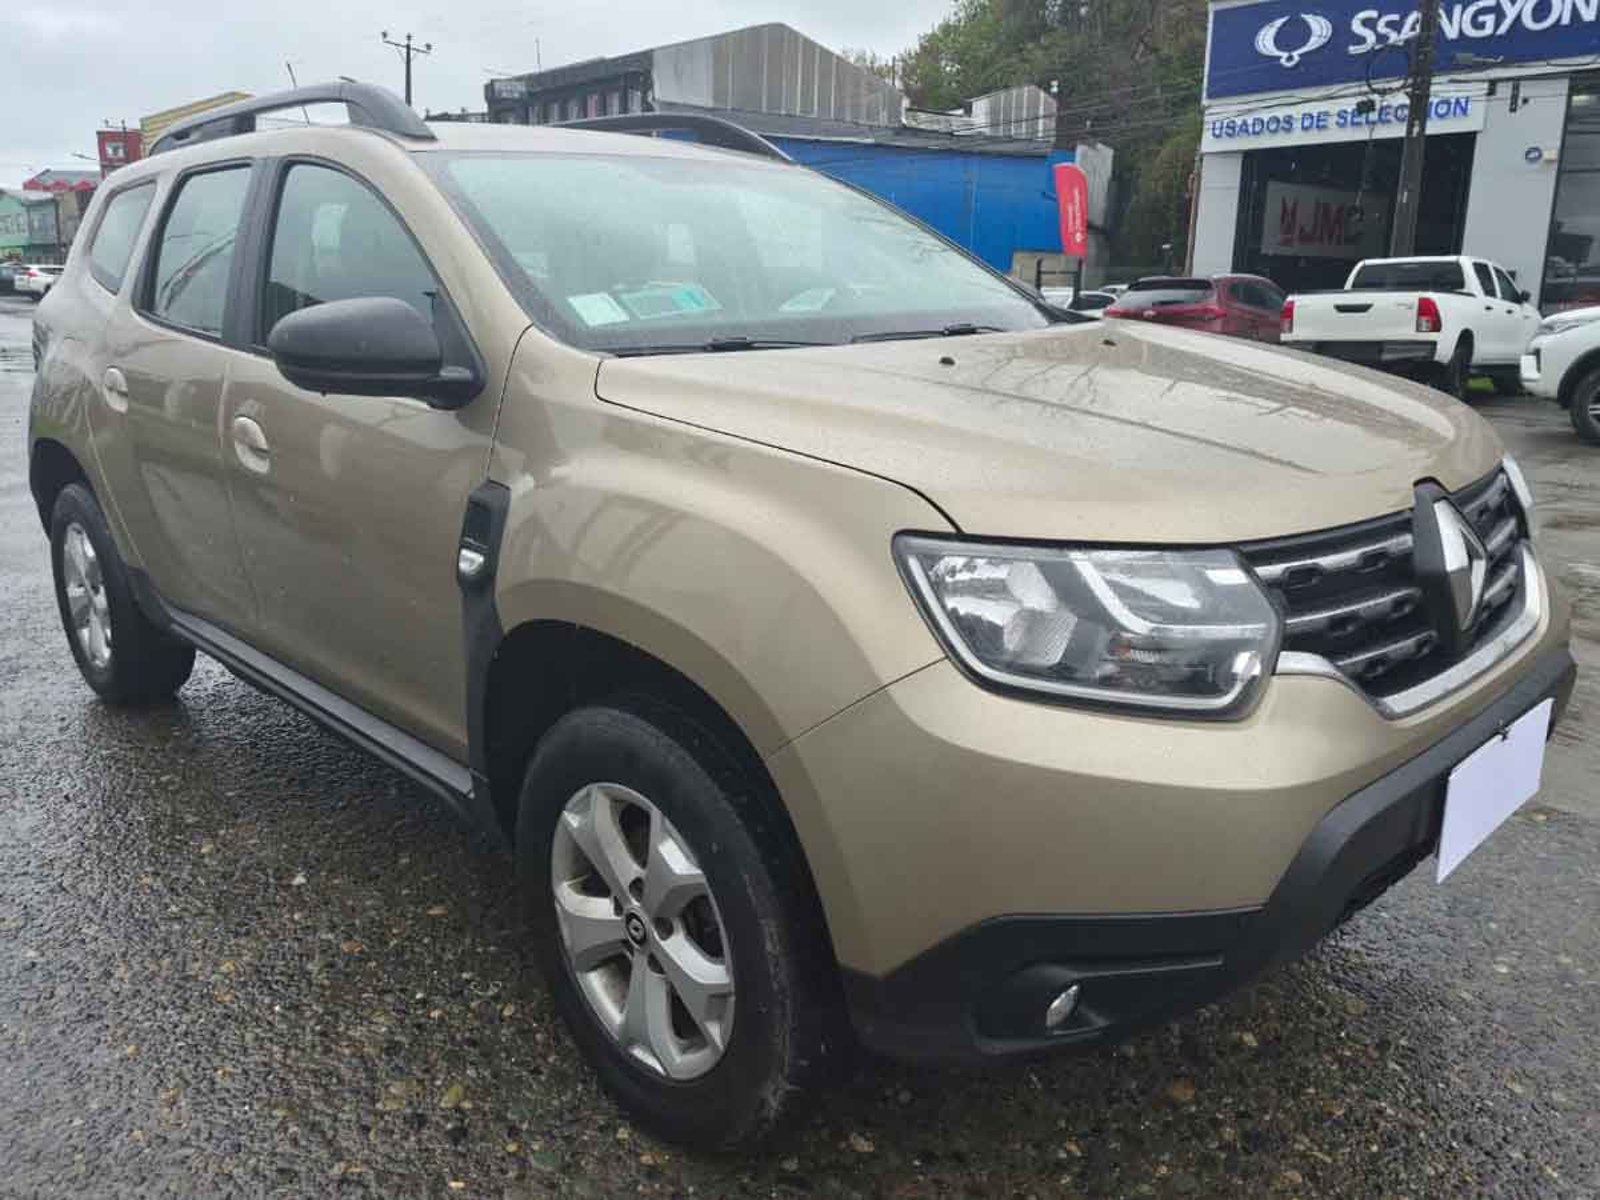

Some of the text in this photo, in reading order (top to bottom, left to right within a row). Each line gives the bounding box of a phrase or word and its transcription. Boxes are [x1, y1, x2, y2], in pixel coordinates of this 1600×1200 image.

[1211, 96, 1470, 139] USADOS DE SELECION
